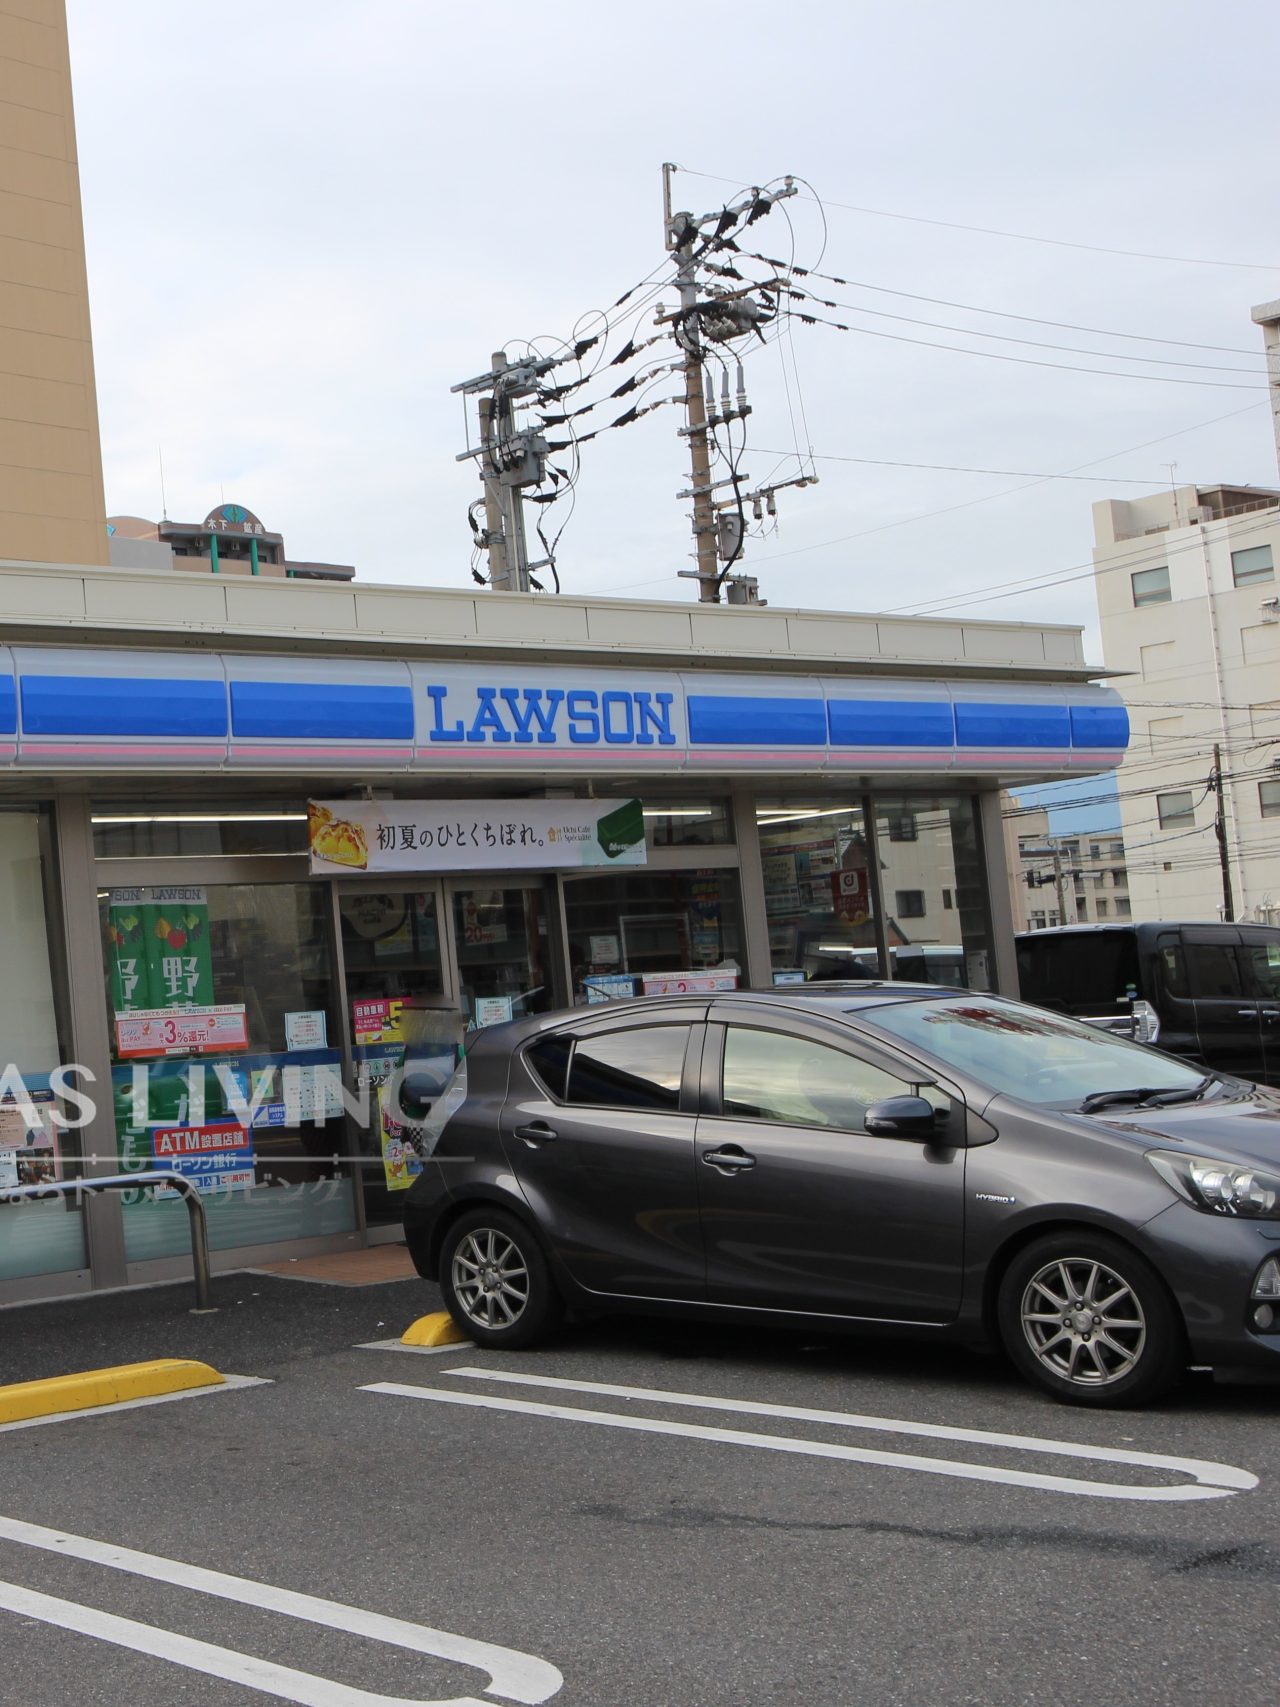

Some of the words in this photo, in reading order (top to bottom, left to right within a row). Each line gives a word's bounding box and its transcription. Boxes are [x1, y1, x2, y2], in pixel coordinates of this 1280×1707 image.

[427, 685, 676, 744] LAWSON
[376, 822, 545, 851] 初夏のひとくちぼれ。
[151, 888, 201, 900] LAWSON
[172, 1153, 237, 1172] ローソン銀行
[975, 1193, 1009, 1205] HYBRID
